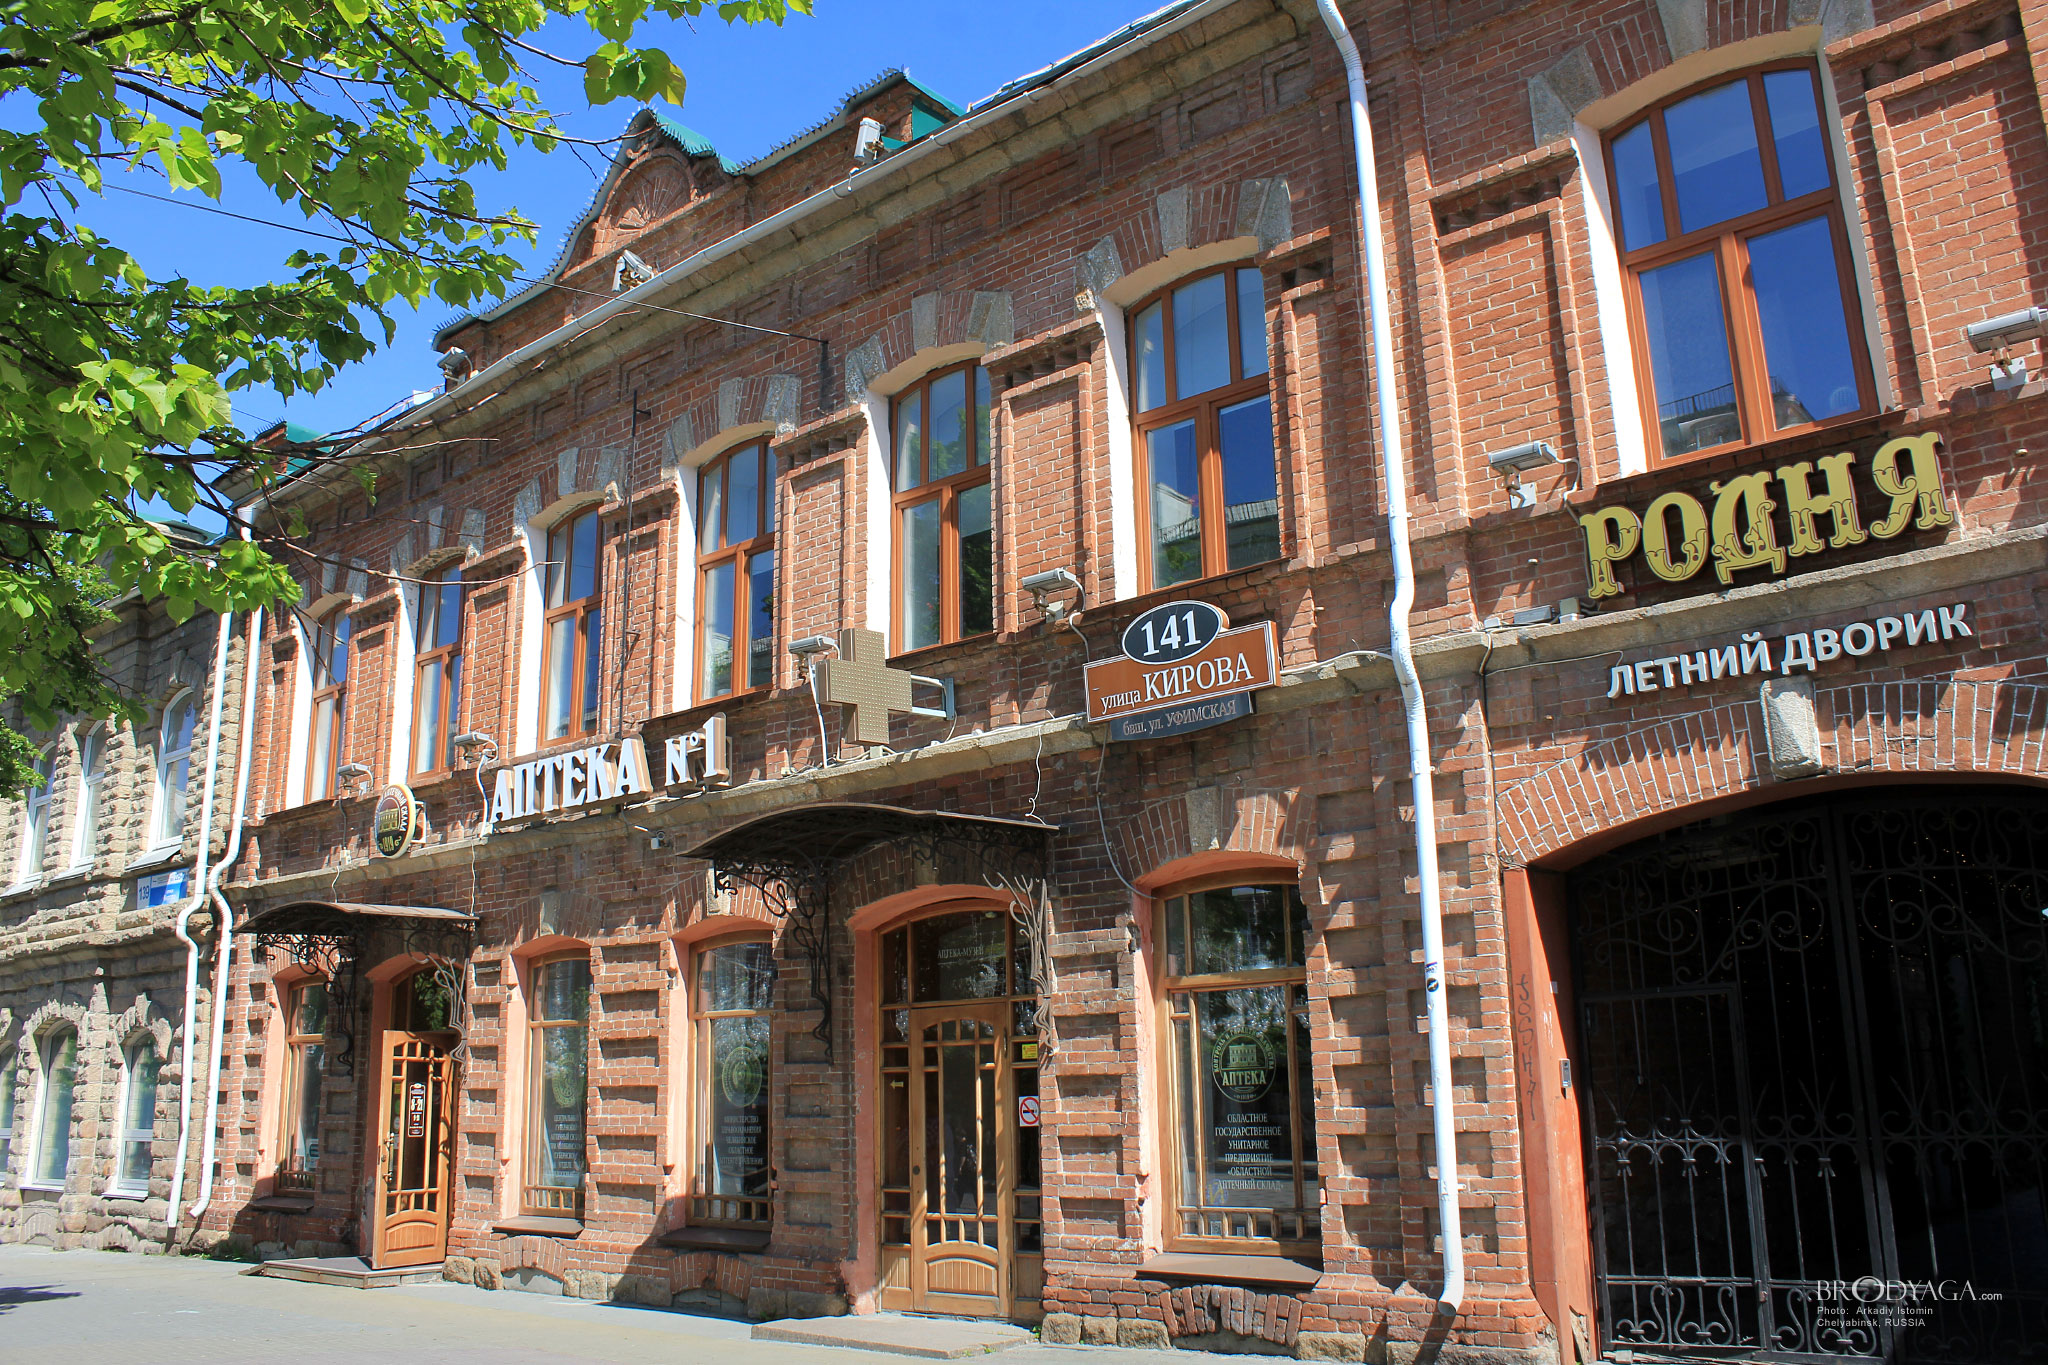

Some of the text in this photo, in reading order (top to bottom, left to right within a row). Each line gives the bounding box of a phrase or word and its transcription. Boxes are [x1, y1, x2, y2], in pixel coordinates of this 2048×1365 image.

[1579, 431, 1955, 598] РОДНЯ
[1141, 610, 1202, 657] 141
[1607, 603, 1974, 699] ЛЕТНИЙ ДВОРИК
[1101, 652, 1255, 715] улица КИРОВА
[1149, 718, 1164, 735] ул.
[1165, 699, 1238, 727] УФИМСКАЯ
[489, 735, 648, 824] АПТЕКА
[1222, 1070, 1267, 1086] АПТЕКА
[1227, 1113, 1268, 1123] ОБЛАСТНОЕ
[1215, 1126, 1282, 1138] ГОСУДАРСТВЕННОЕ
[1228, 1140, 1270, 1150] УНИТАРНОЕ
[1225, 1153, 1274, 1164] ПРЕДПРИЯТИЕ
[1218, 1178, 1256, 1190] АПТЕЧНЫЙ
